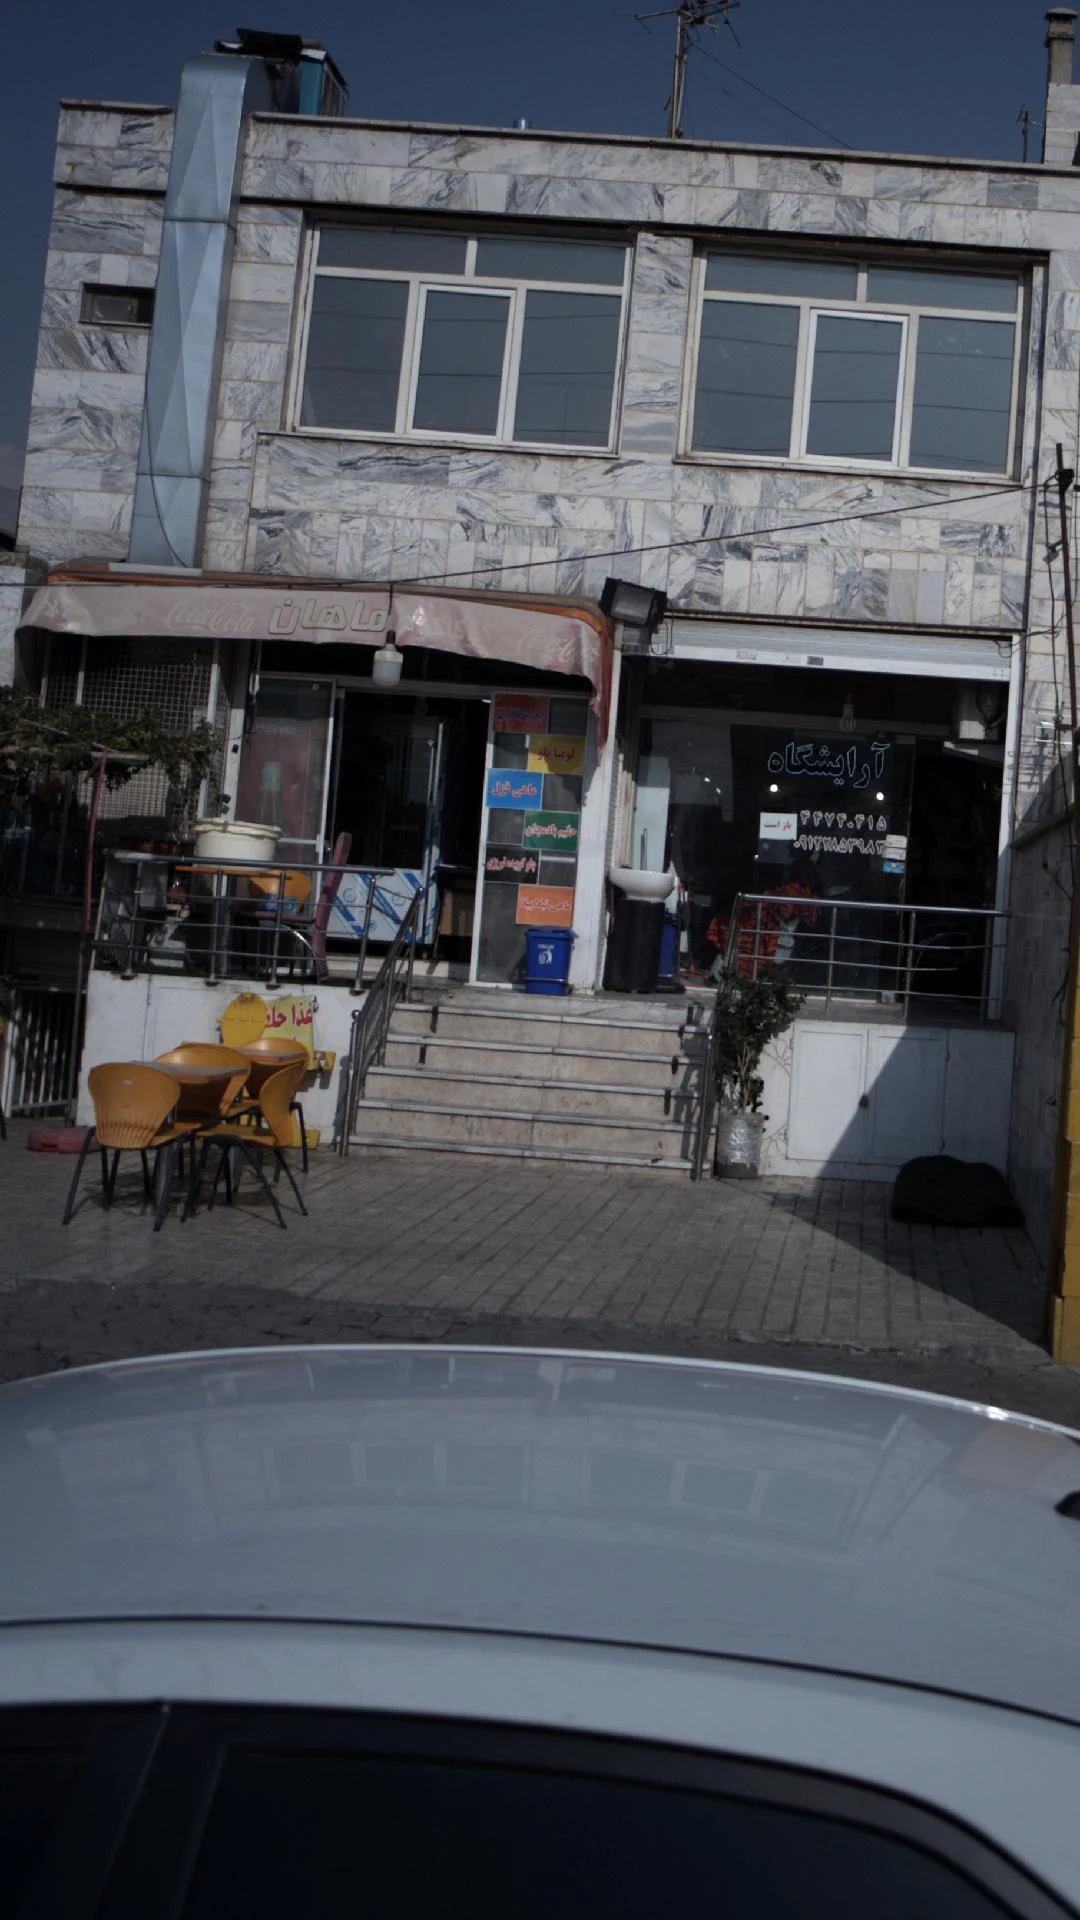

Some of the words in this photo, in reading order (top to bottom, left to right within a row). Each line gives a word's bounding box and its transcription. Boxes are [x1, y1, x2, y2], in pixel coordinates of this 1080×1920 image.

[268, 599, 389, 635] ماهان
[767, 741, 891, 789] آرایشگاه
[511, 783, 538, 799] ماهی
[764, 821, 780, 830] است
[782, 819, 792, 832] باز
